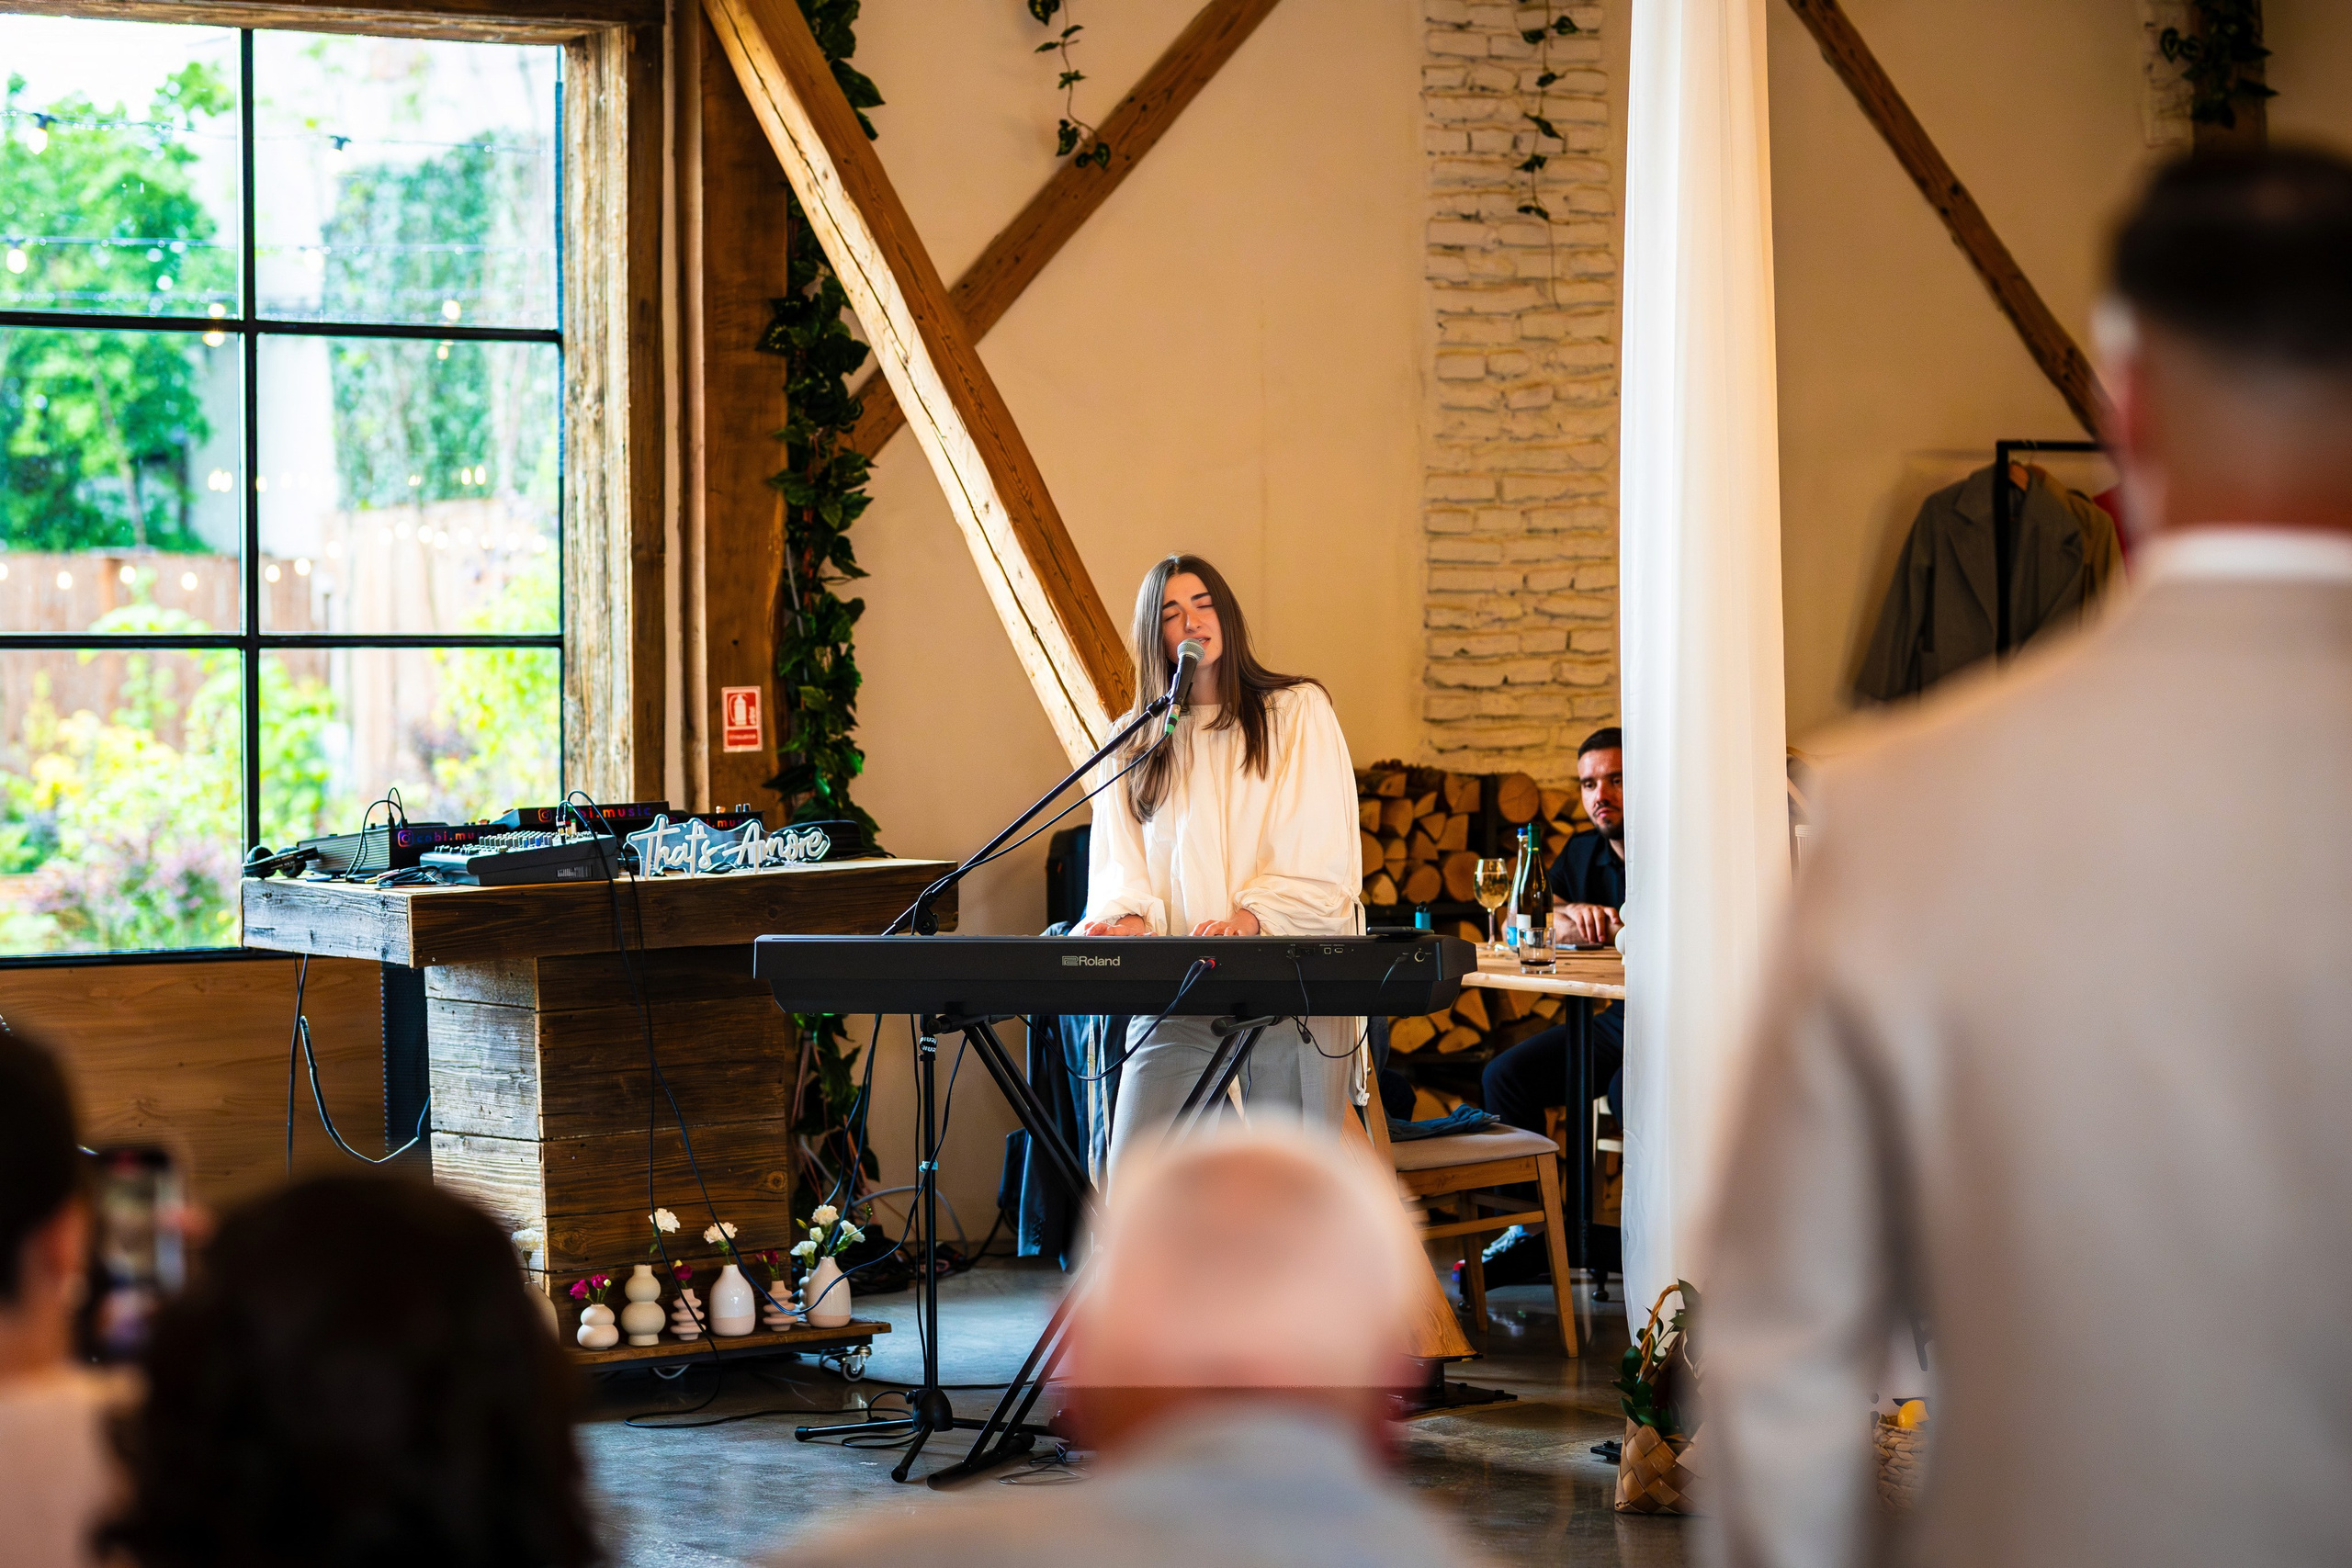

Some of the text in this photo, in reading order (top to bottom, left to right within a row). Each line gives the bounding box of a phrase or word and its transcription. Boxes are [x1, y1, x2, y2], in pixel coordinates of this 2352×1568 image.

[577, 805, 651, 819] bi.music
[721, 821, 828, 874] Amore
[1079, 955, 1121, 966] Roland
